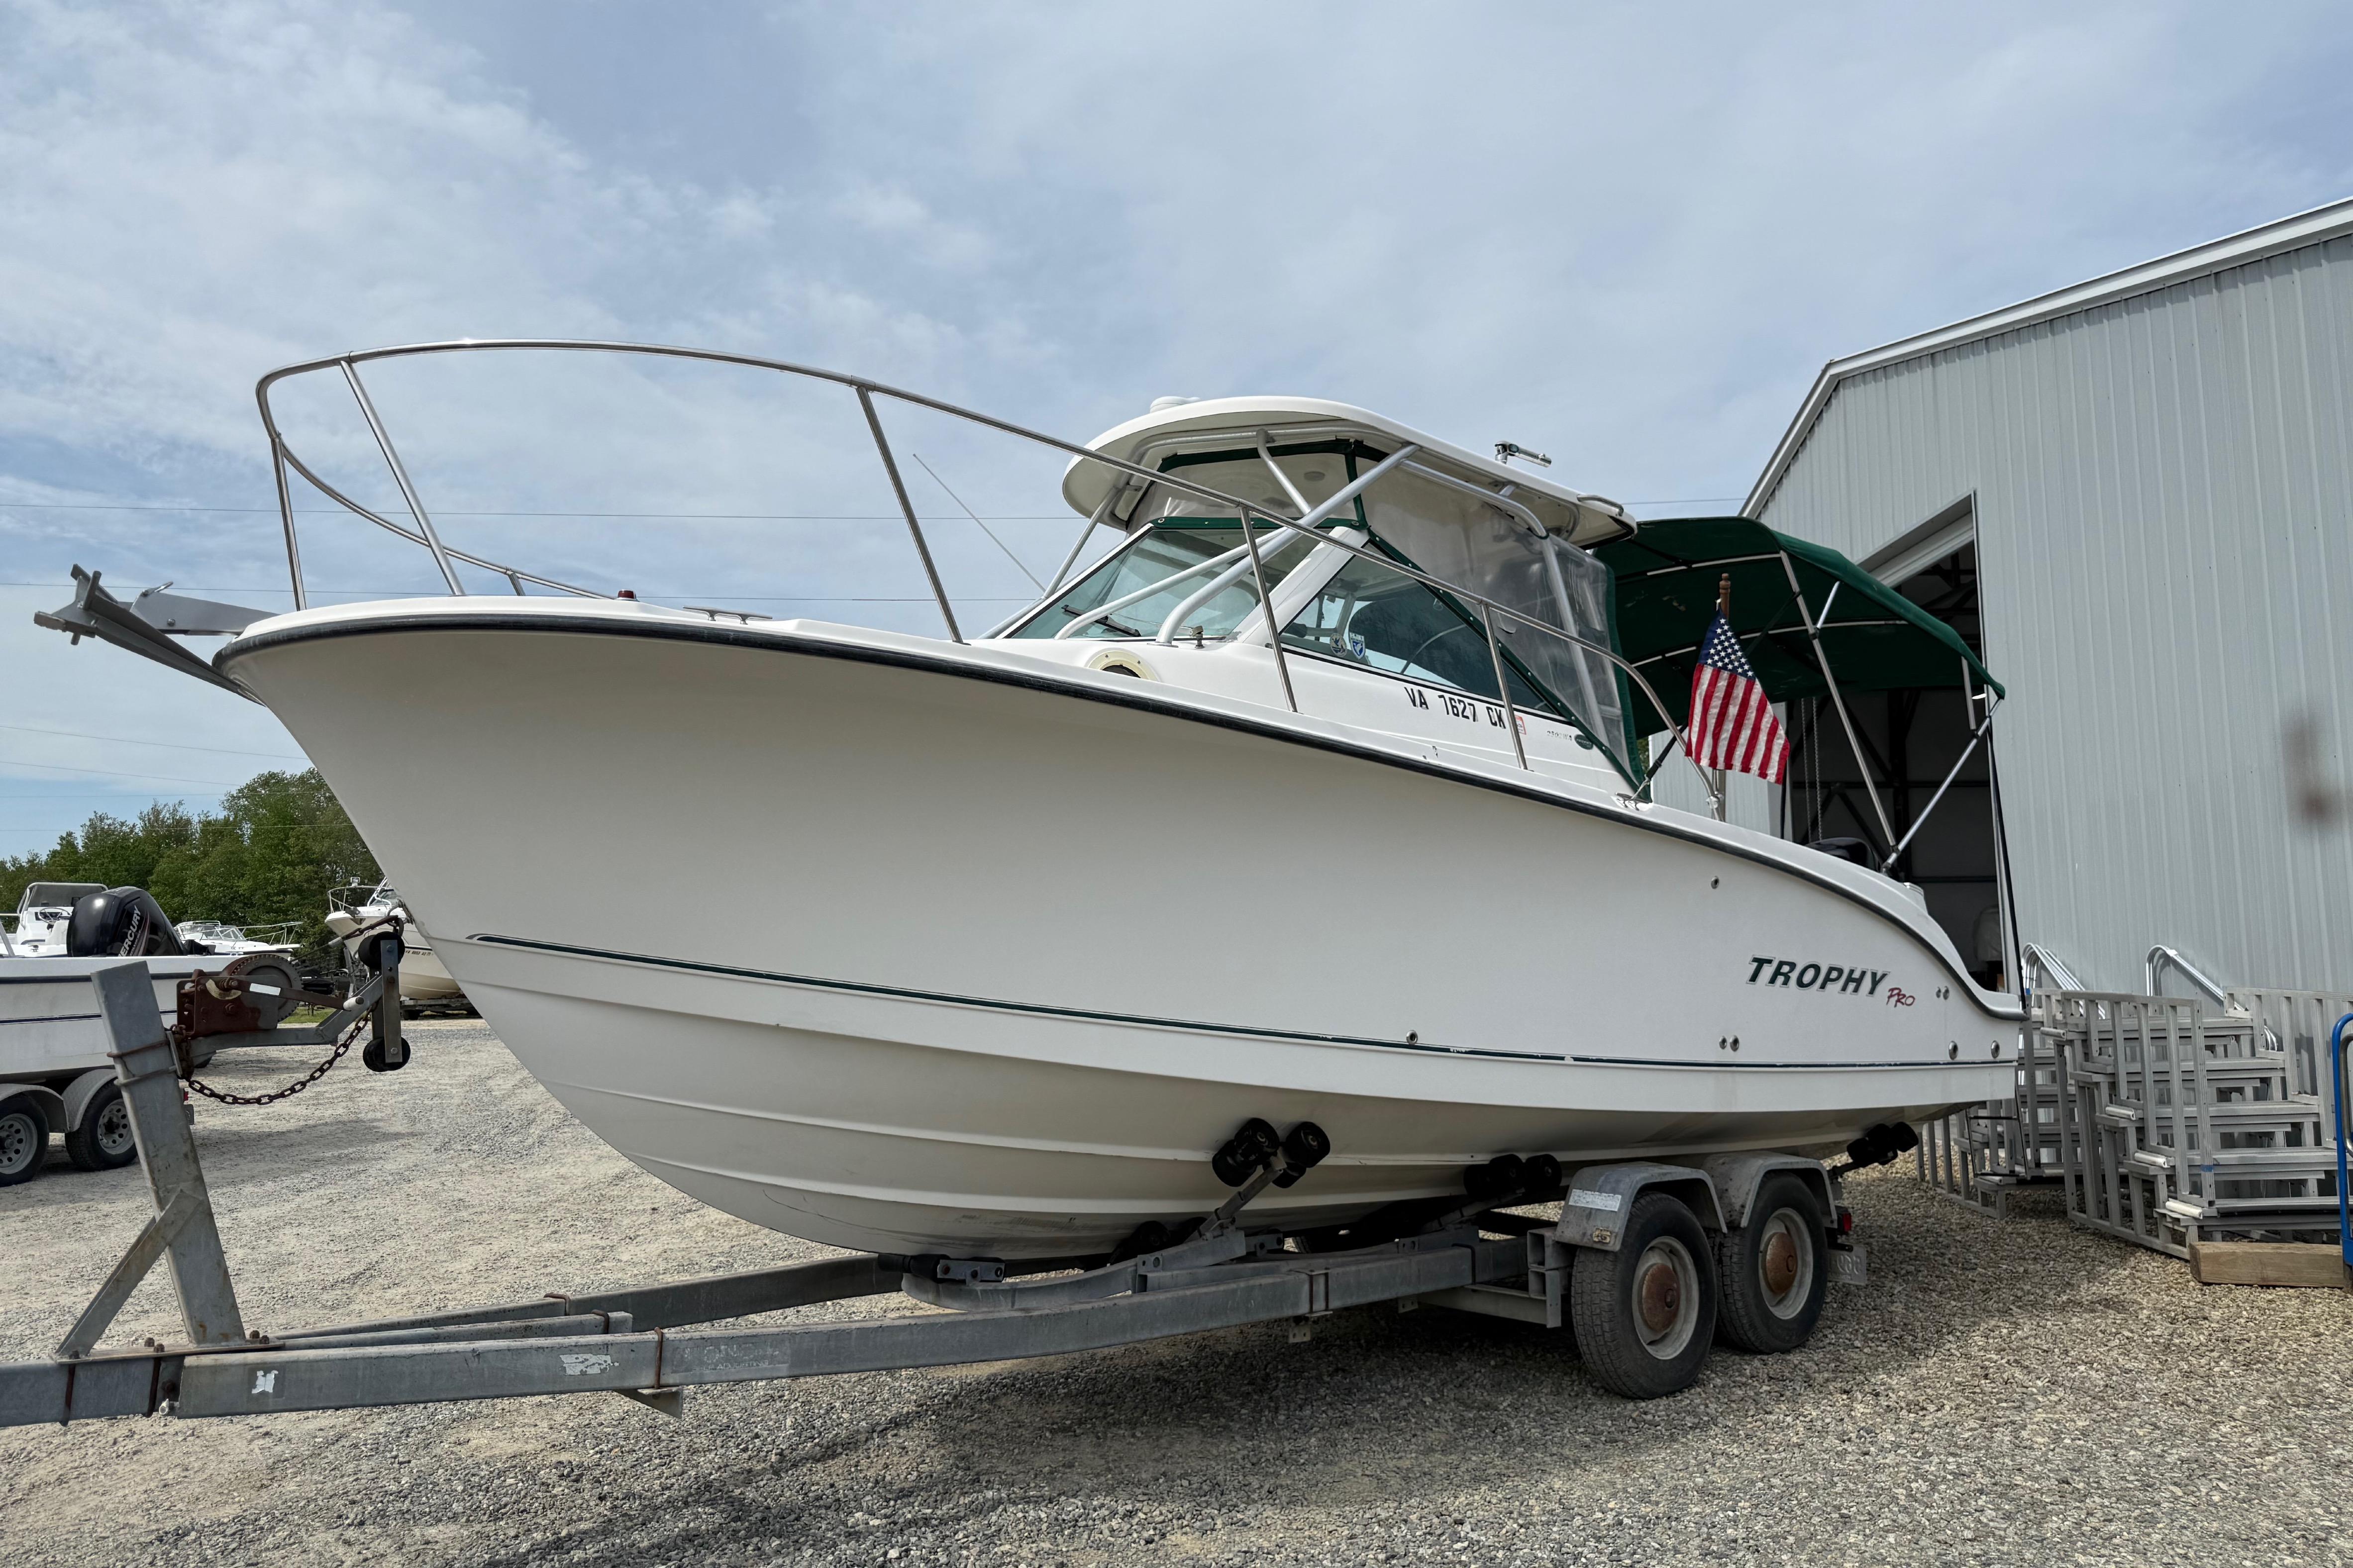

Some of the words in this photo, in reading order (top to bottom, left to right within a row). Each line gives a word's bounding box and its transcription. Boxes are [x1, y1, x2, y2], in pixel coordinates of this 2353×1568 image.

[1404, 686, 1429, 710] VA
[1438, 694, 1478, 722] 7627
[1486, 705, 1506, 729] CK
[118, 905, 141, 957] ERCURY
[1746, 954, 1891, 997] TROPHY
[1886, 987, 1916, 1008] PRO
